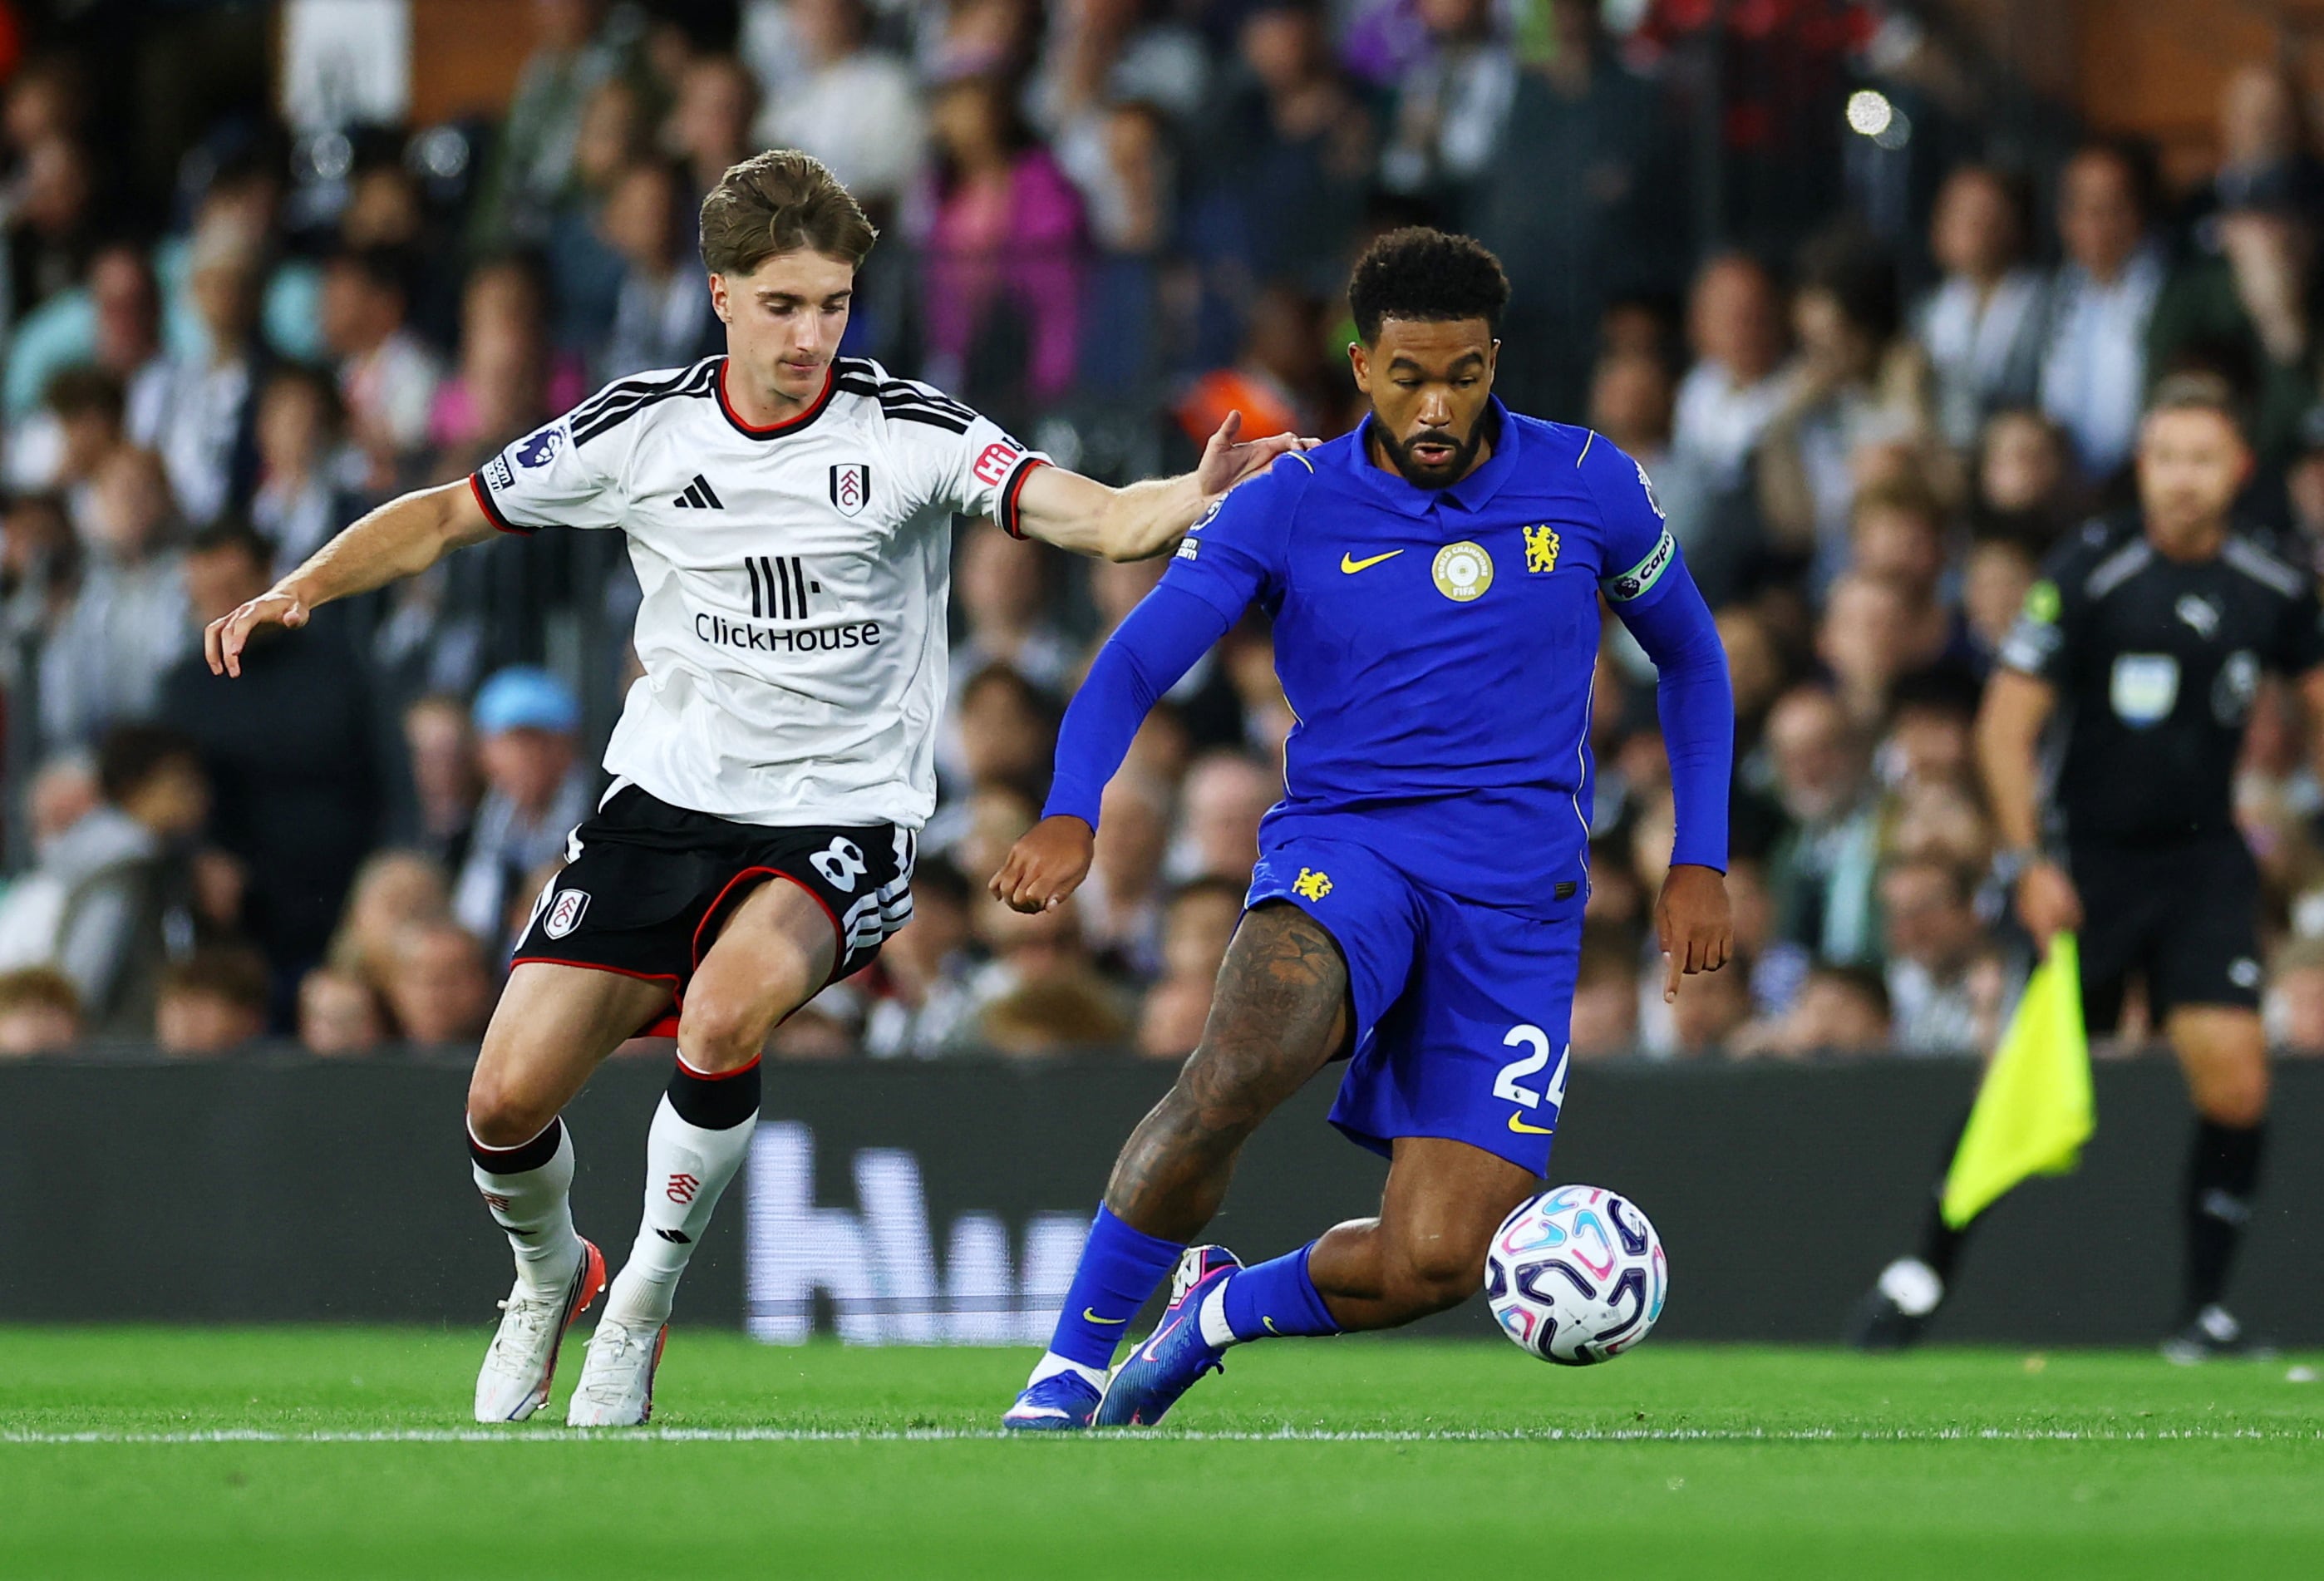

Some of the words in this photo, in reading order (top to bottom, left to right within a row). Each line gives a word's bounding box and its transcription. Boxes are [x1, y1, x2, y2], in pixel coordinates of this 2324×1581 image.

[1452, 585, 1477, 597] FIFA
[696, 613, 880, 653] ClickHouse
[809, 835, 868, 893] 8
